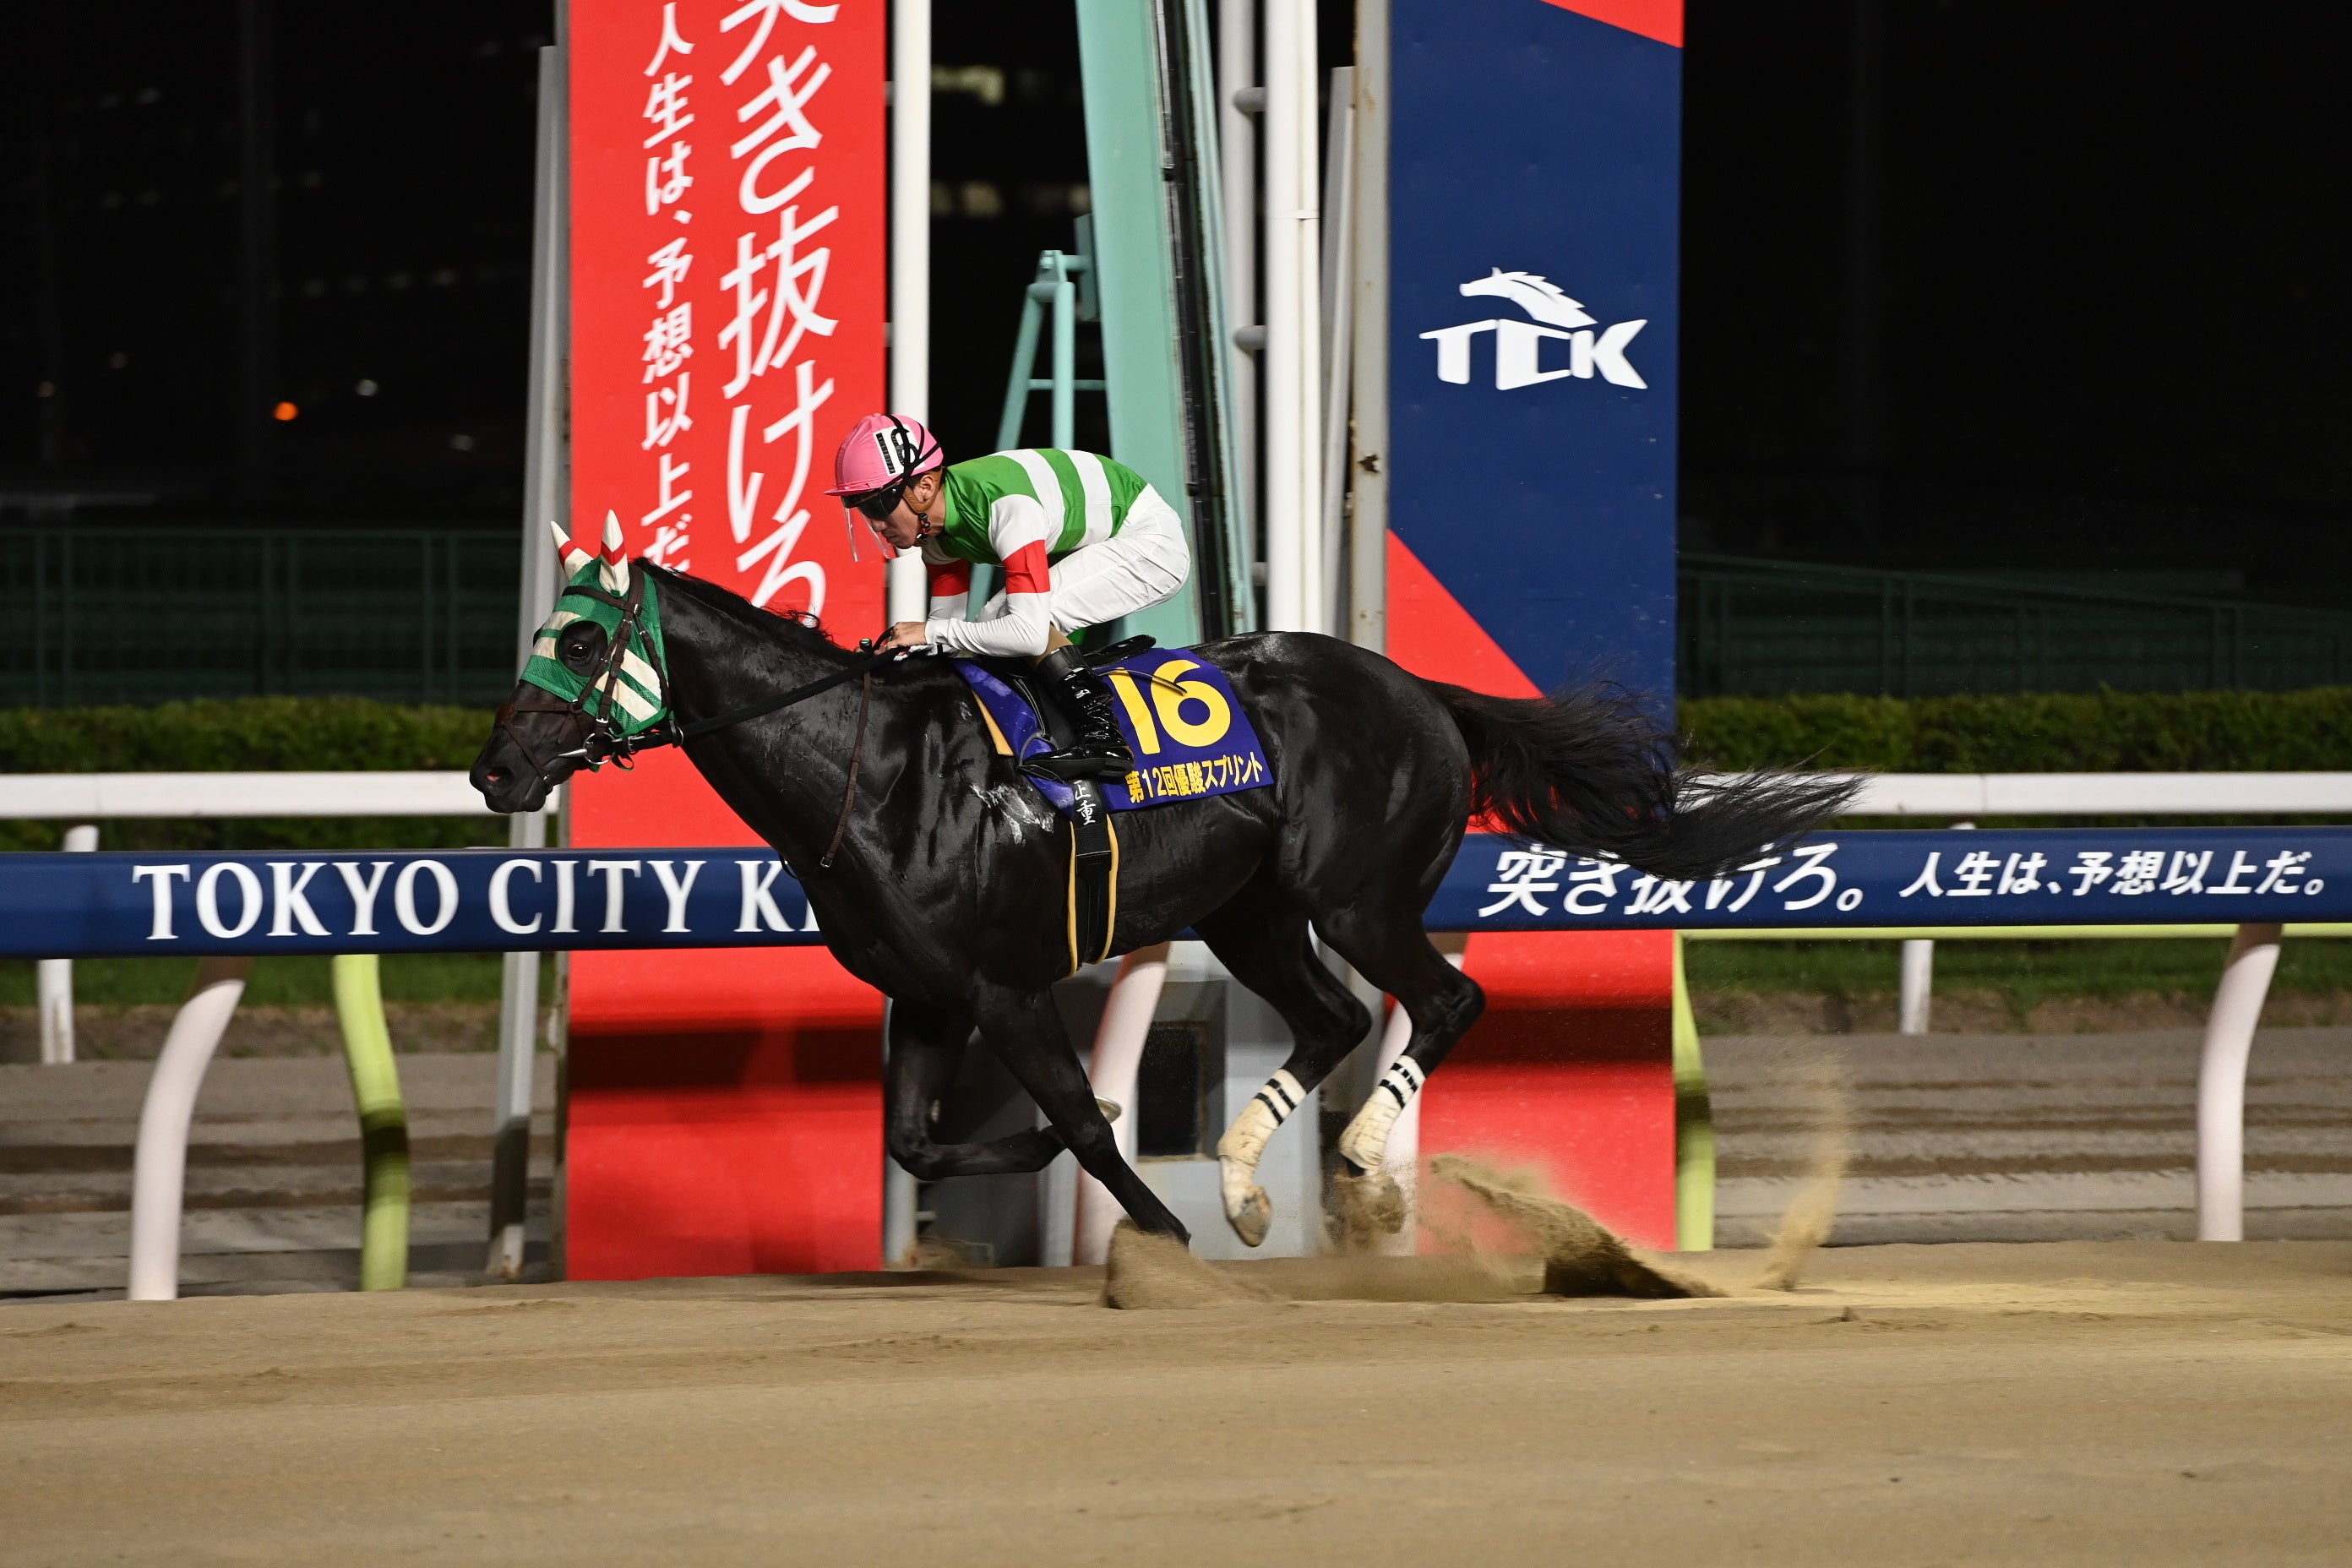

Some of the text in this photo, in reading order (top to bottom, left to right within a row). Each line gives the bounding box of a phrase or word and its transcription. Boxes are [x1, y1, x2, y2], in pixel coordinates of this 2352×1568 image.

[1418, 318, 1648, 390] TCK
[1106, 659, 1232, 755] 16
[1124, 751, 1263, 803] 第12回優駿スプリント
[132, 858, 460, 940] TOKYO
[487, 858, 708, 934] CITY
[1898, 849, 2325, 897] 人生は、予想以上だ。
